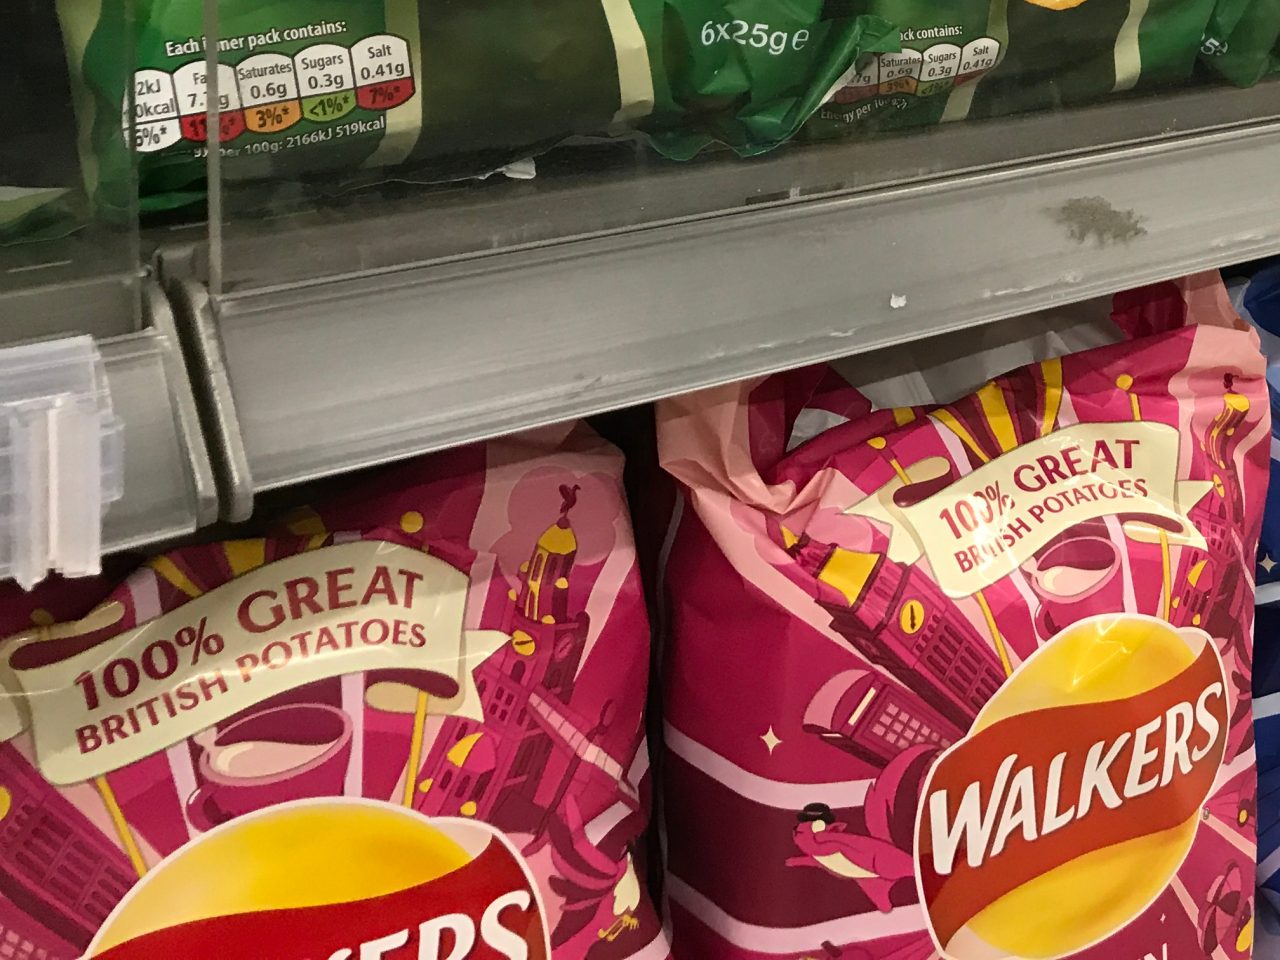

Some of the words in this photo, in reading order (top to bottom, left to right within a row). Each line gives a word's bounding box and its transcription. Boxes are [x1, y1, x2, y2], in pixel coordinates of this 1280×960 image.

[165, 40, 199, 57] Each
[247, 30, 281, 50] pack
[283, 20, 347, 42] contains:
[916, 25, 963, 41] contains:
[368, 44, 392, 59] Salt
[928, 50, 957, 64] Sugars
[972, 44, 989, 57] Salt
[238, 61, 292, 81] Saturates
[301, 53, 345, 72] Sugars
[360, 62, 405, 81] 0.41g
[927, 66, 953, 78] 0.3g
[250, 82, 288, 100] 0.6g
[308, 73, 345, 91] 0.3g
[287, 131, 333, 150] 2166kJ
[335, 117, 386, 138] 519kcal
[939, 480, 1016, 540] 100%
[1013, 439, 1140, 492] GREAT
[1027, 478, 1149, 524] POTATOES
[73, 616, 225, 711] 100%
[236, 565, 425, 635] GREAT
[75, 672, 228, 755] BRITISH
[234, 617, 428, 682] POTATOES
[929, 682, 1224, 875] WALKERS
